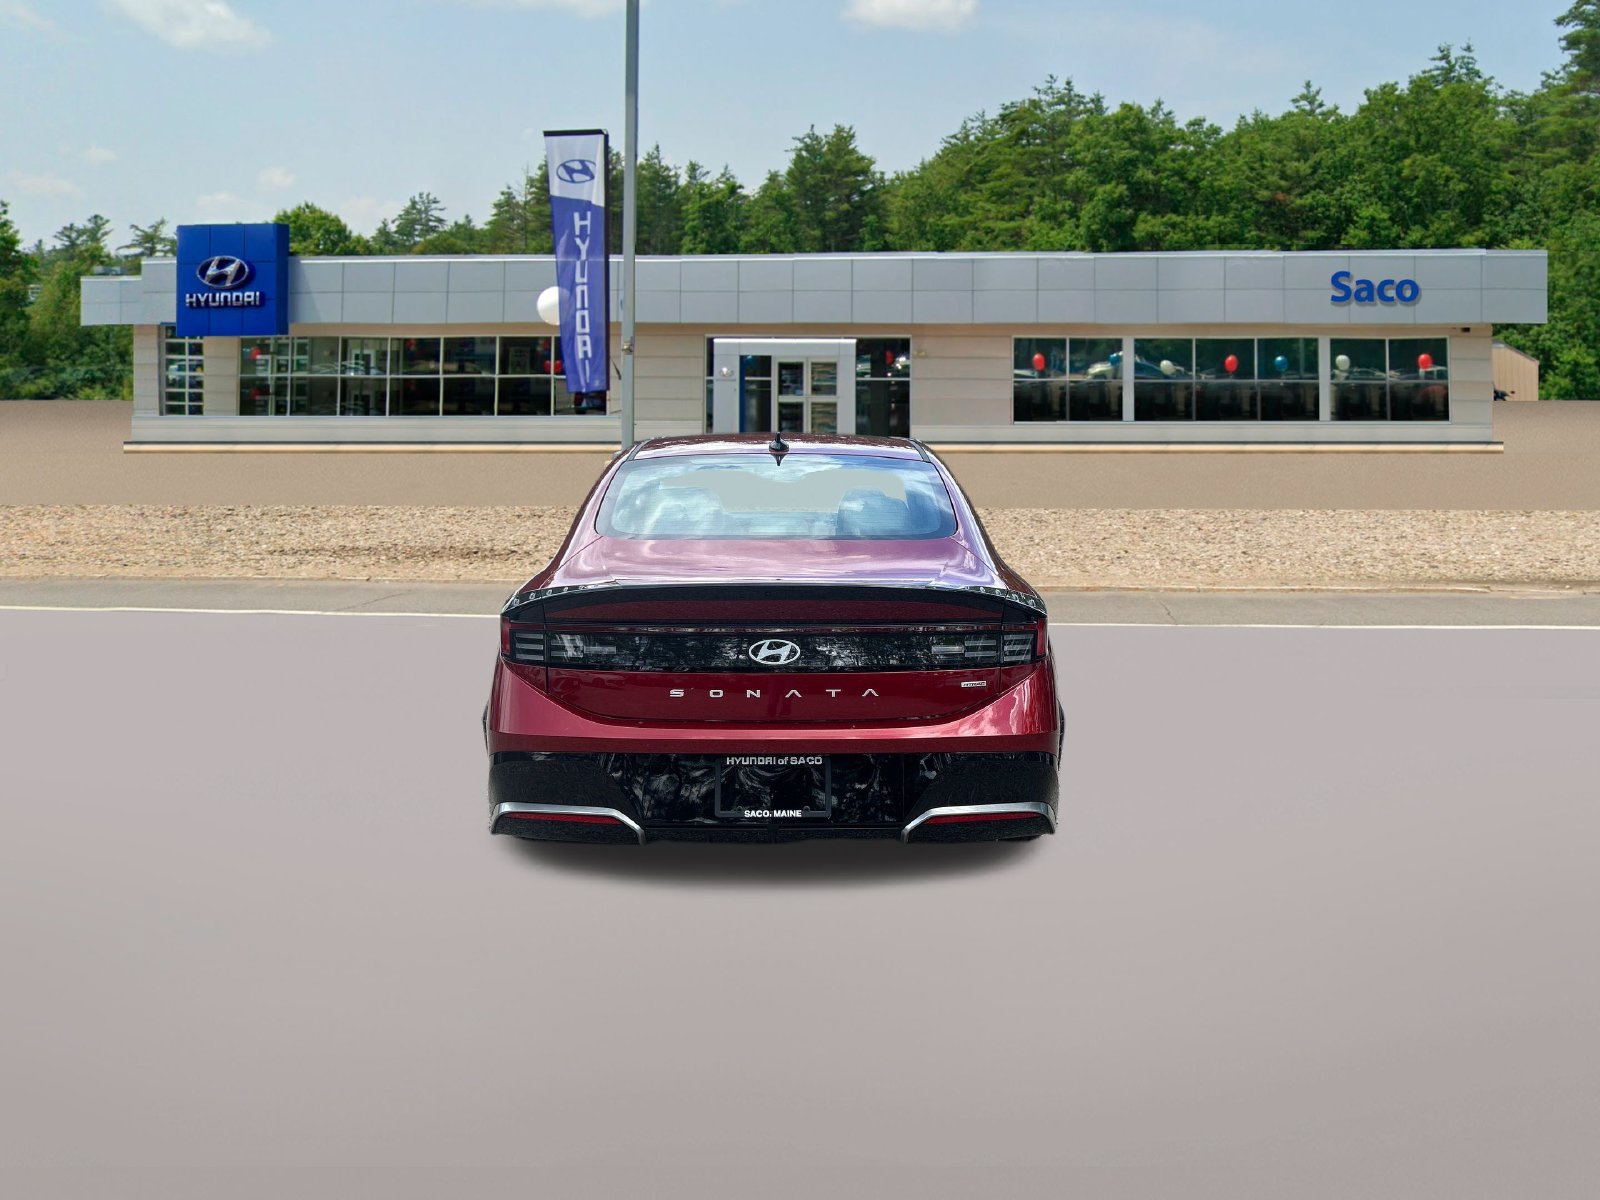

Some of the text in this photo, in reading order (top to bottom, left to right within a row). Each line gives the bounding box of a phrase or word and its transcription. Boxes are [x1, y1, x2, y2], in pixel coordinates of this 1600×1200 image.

[1330, 270, 1420, 303] Saco
[185, 291, 260, 307] HYUNDAI
[573, 211, 592, 383] HYUNDAI
[669, 688, 879, 698] SONATA
[726, 756, 823, 765] HYUNDAI of SACO
[773, 809, 802, 818] MAINE
